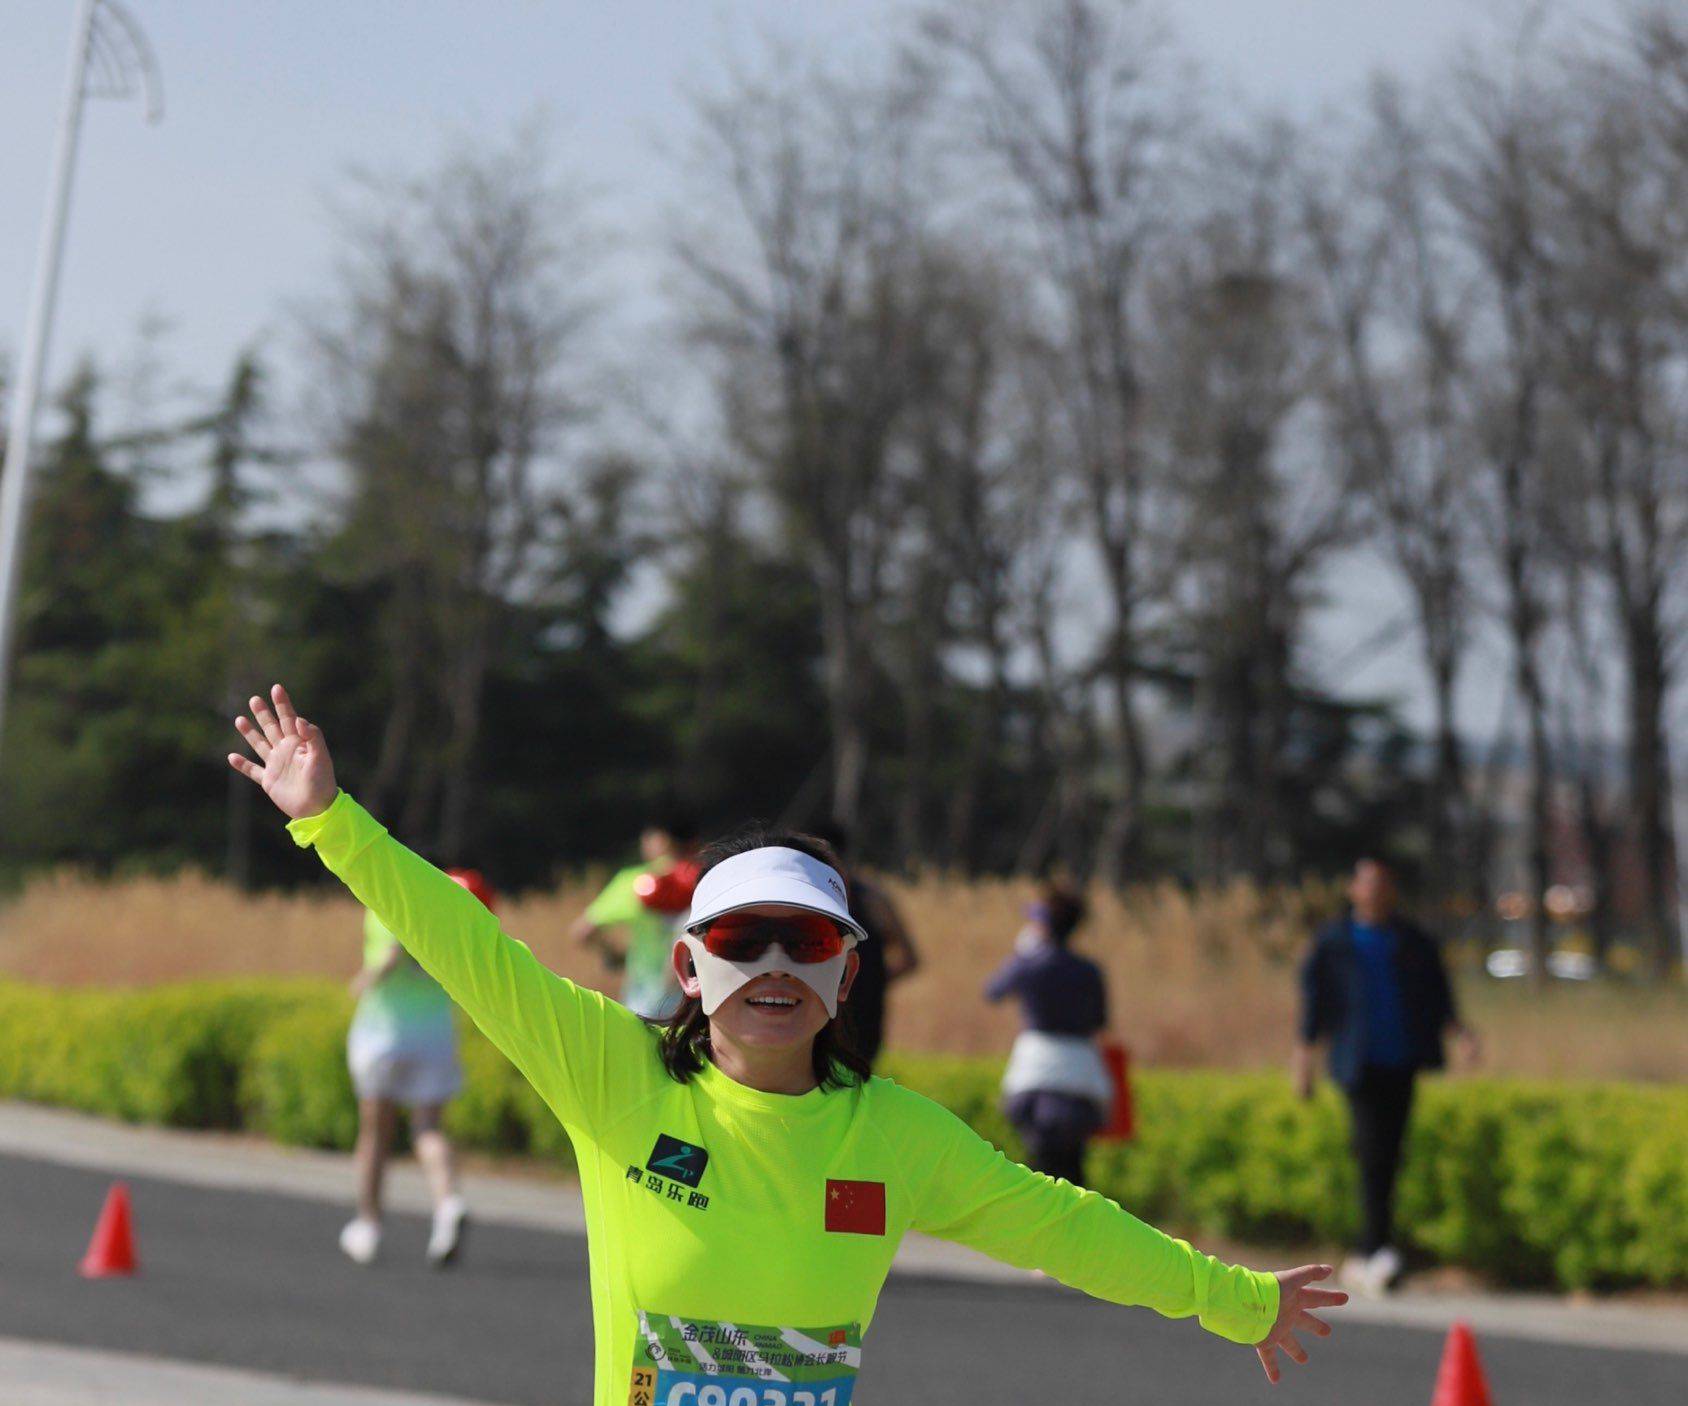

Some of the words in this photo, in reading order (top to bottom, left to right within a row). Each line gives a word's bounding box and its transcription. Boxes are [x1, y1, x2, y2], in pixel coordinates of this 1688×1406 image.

[626, 1164, 710, 1211] 青岛乐跑
[681, 1323, 749, 1347] 金茂山东
